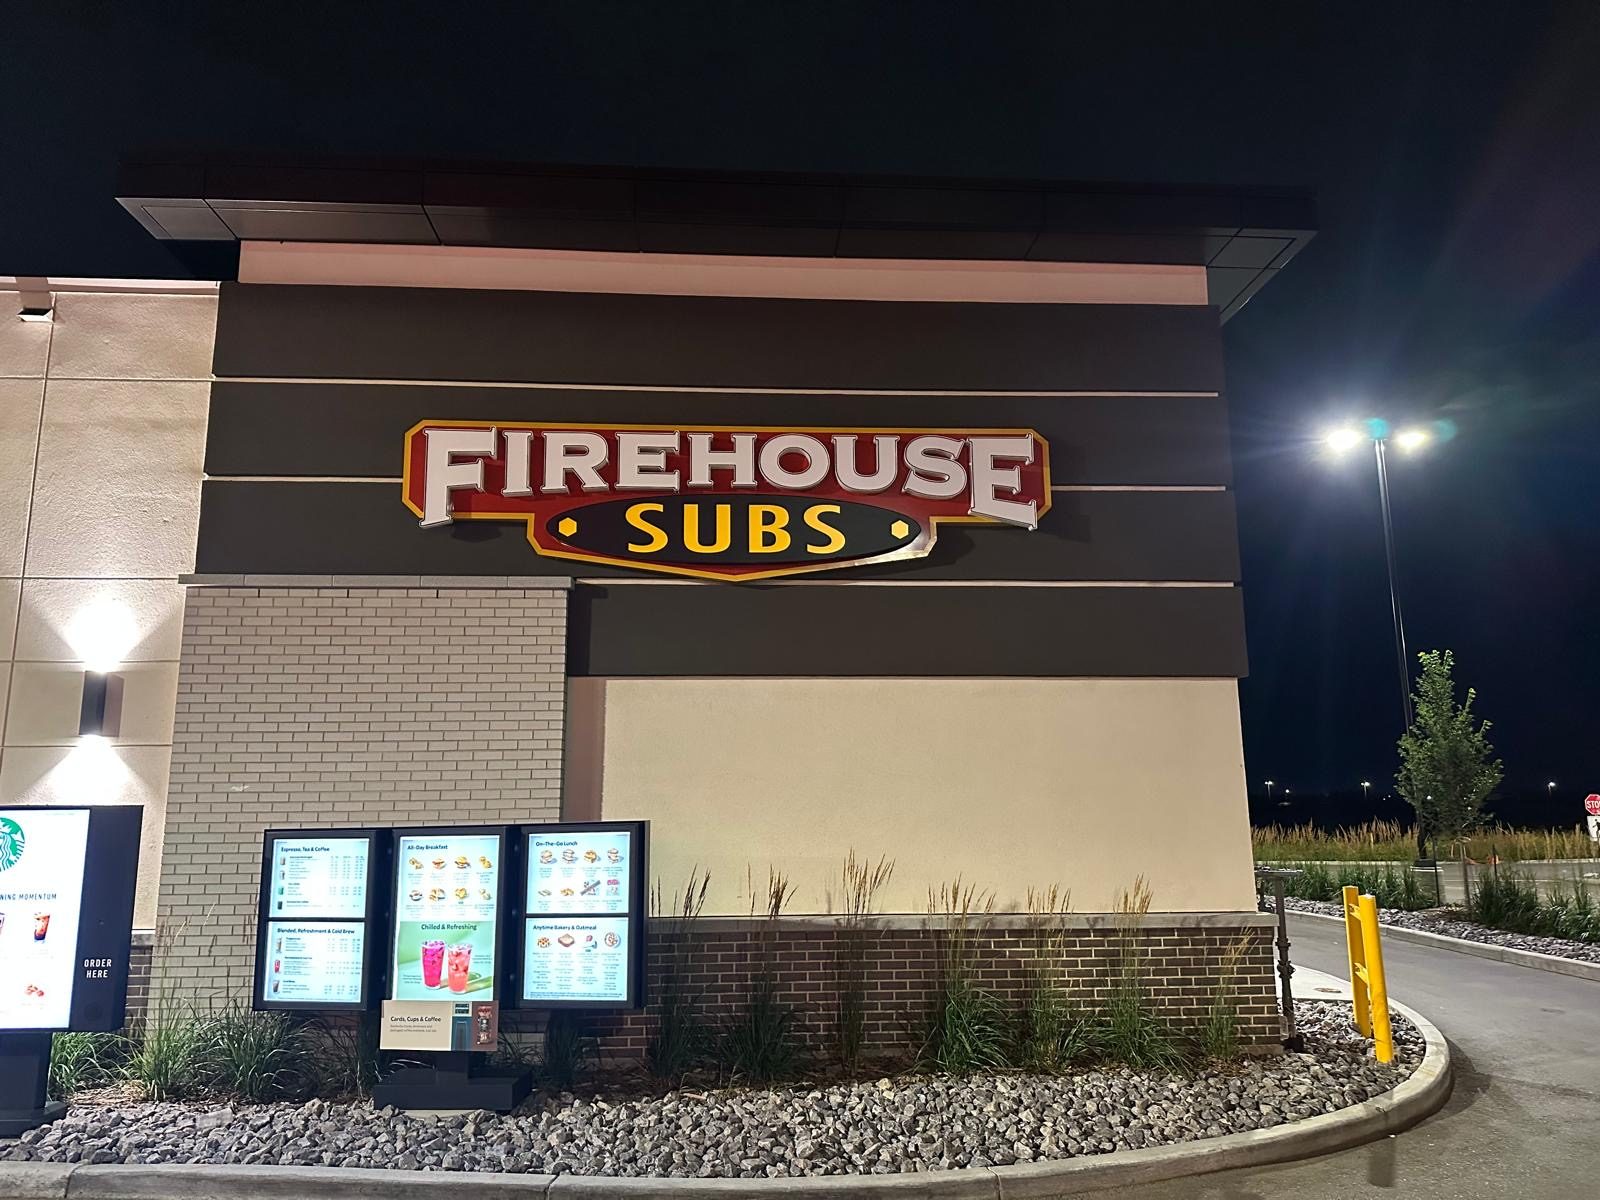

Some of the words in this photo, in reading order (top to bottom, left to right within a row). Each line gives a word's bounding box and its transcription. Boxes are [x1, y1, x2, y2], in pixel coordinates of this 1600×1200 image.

[419, 426, 1039, 532] FIREHOUSE
[624, 502, 848, 556] SUBS
[1586, 800, 1600, 809] STO
[447, 923, 477, 931] Refreshing
[84, 958, 112, 968] ORDER
[86, 969, 109, 979] HERE
